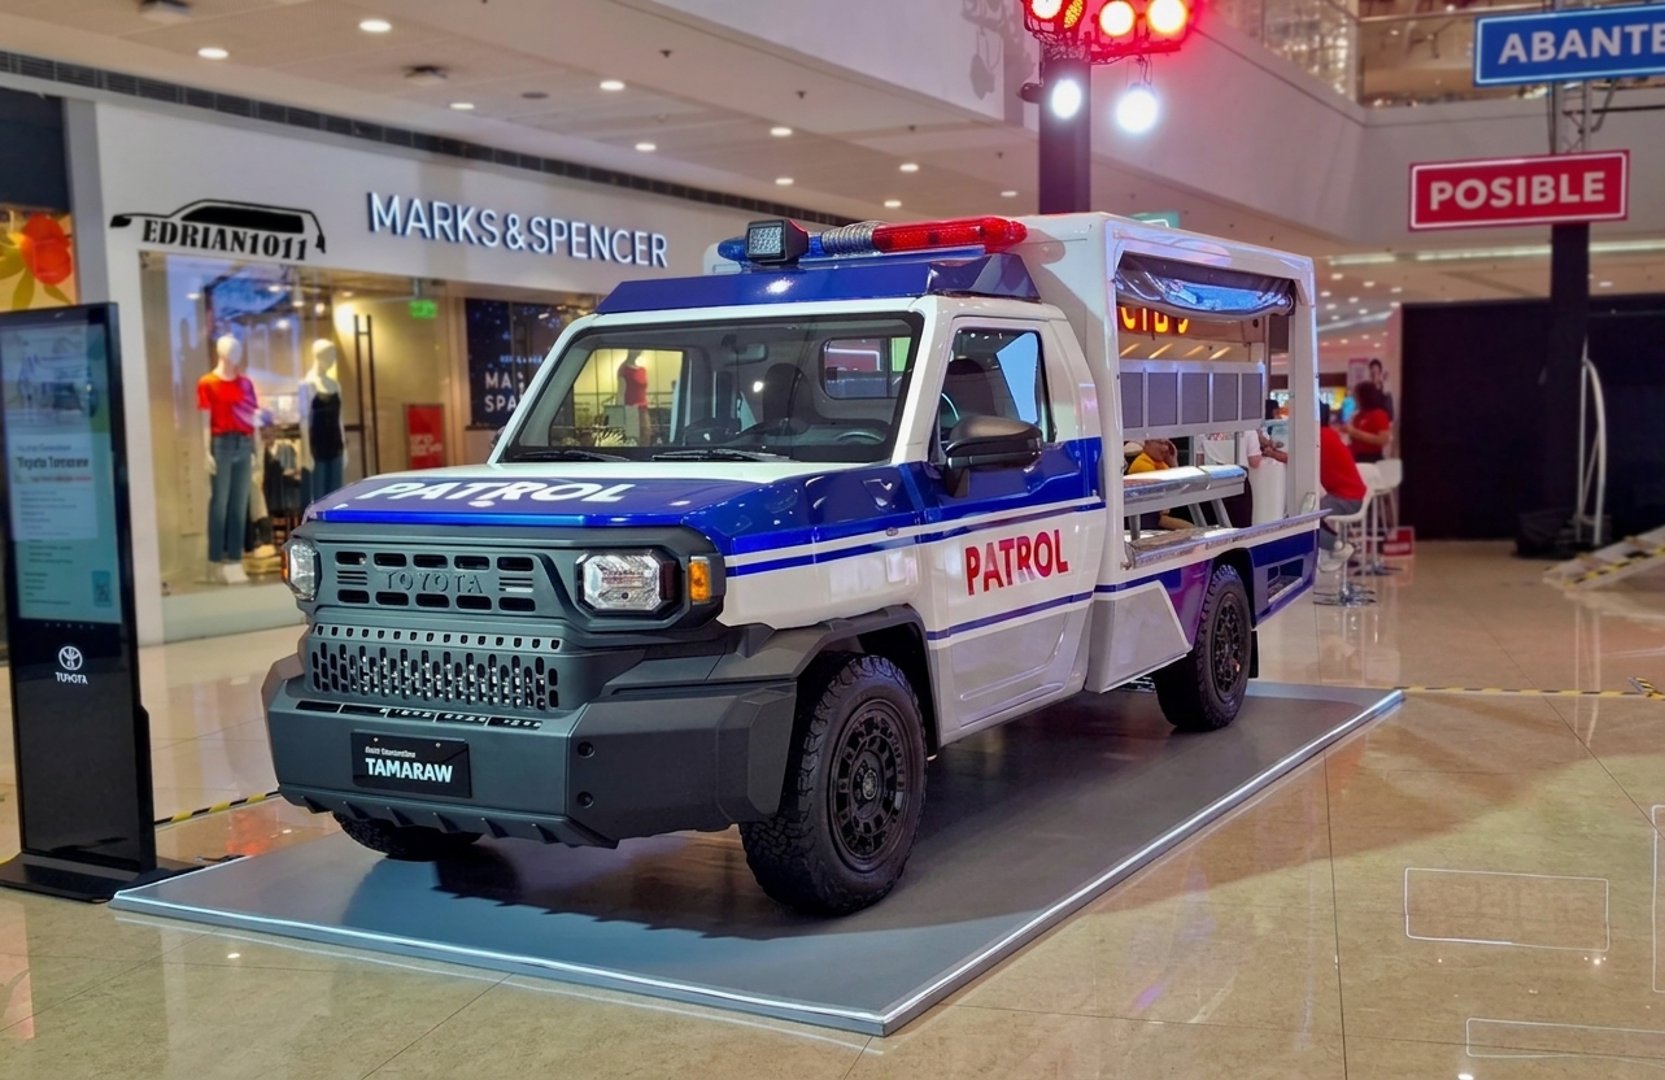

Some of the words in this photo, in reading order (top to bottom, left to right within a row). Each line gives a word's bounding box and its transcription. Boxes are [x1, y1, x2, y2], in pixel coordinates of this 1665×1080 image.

[1497, 23, 1665, 64] ABANTE
[1429, 171, 1606, 211] POSIBLE
[355, 481, 636, 502] PATROL
[965, 529, 1069, 596] PATROL
[385, 571, 484, 594] TOYOTA
[365, 757, 453, 783] TAMARAW
